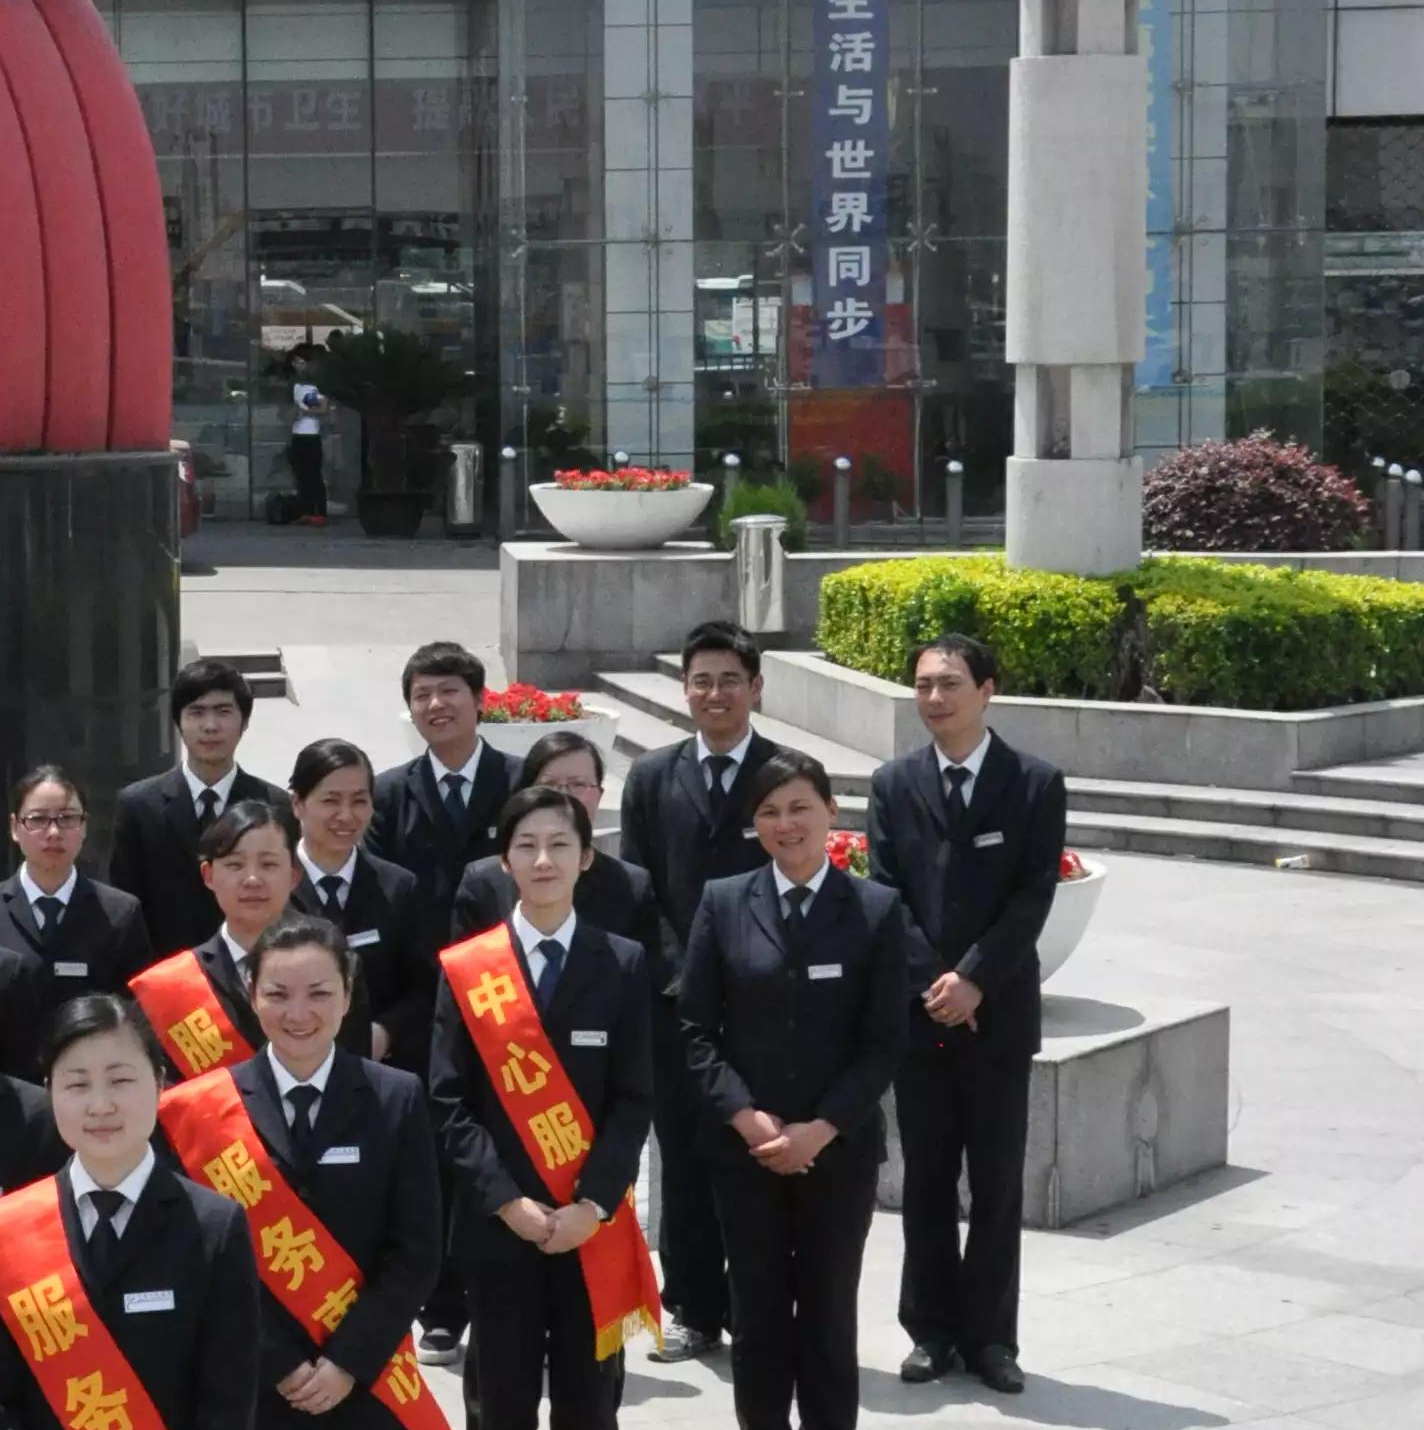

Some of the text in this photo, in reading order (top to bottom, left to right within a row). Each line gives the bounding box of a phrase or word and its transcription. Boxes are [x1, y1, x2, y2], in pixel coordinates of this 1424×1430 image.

[167, 1007, 233, 1074] 服
[468, 971, 591, 1169] 中心服
